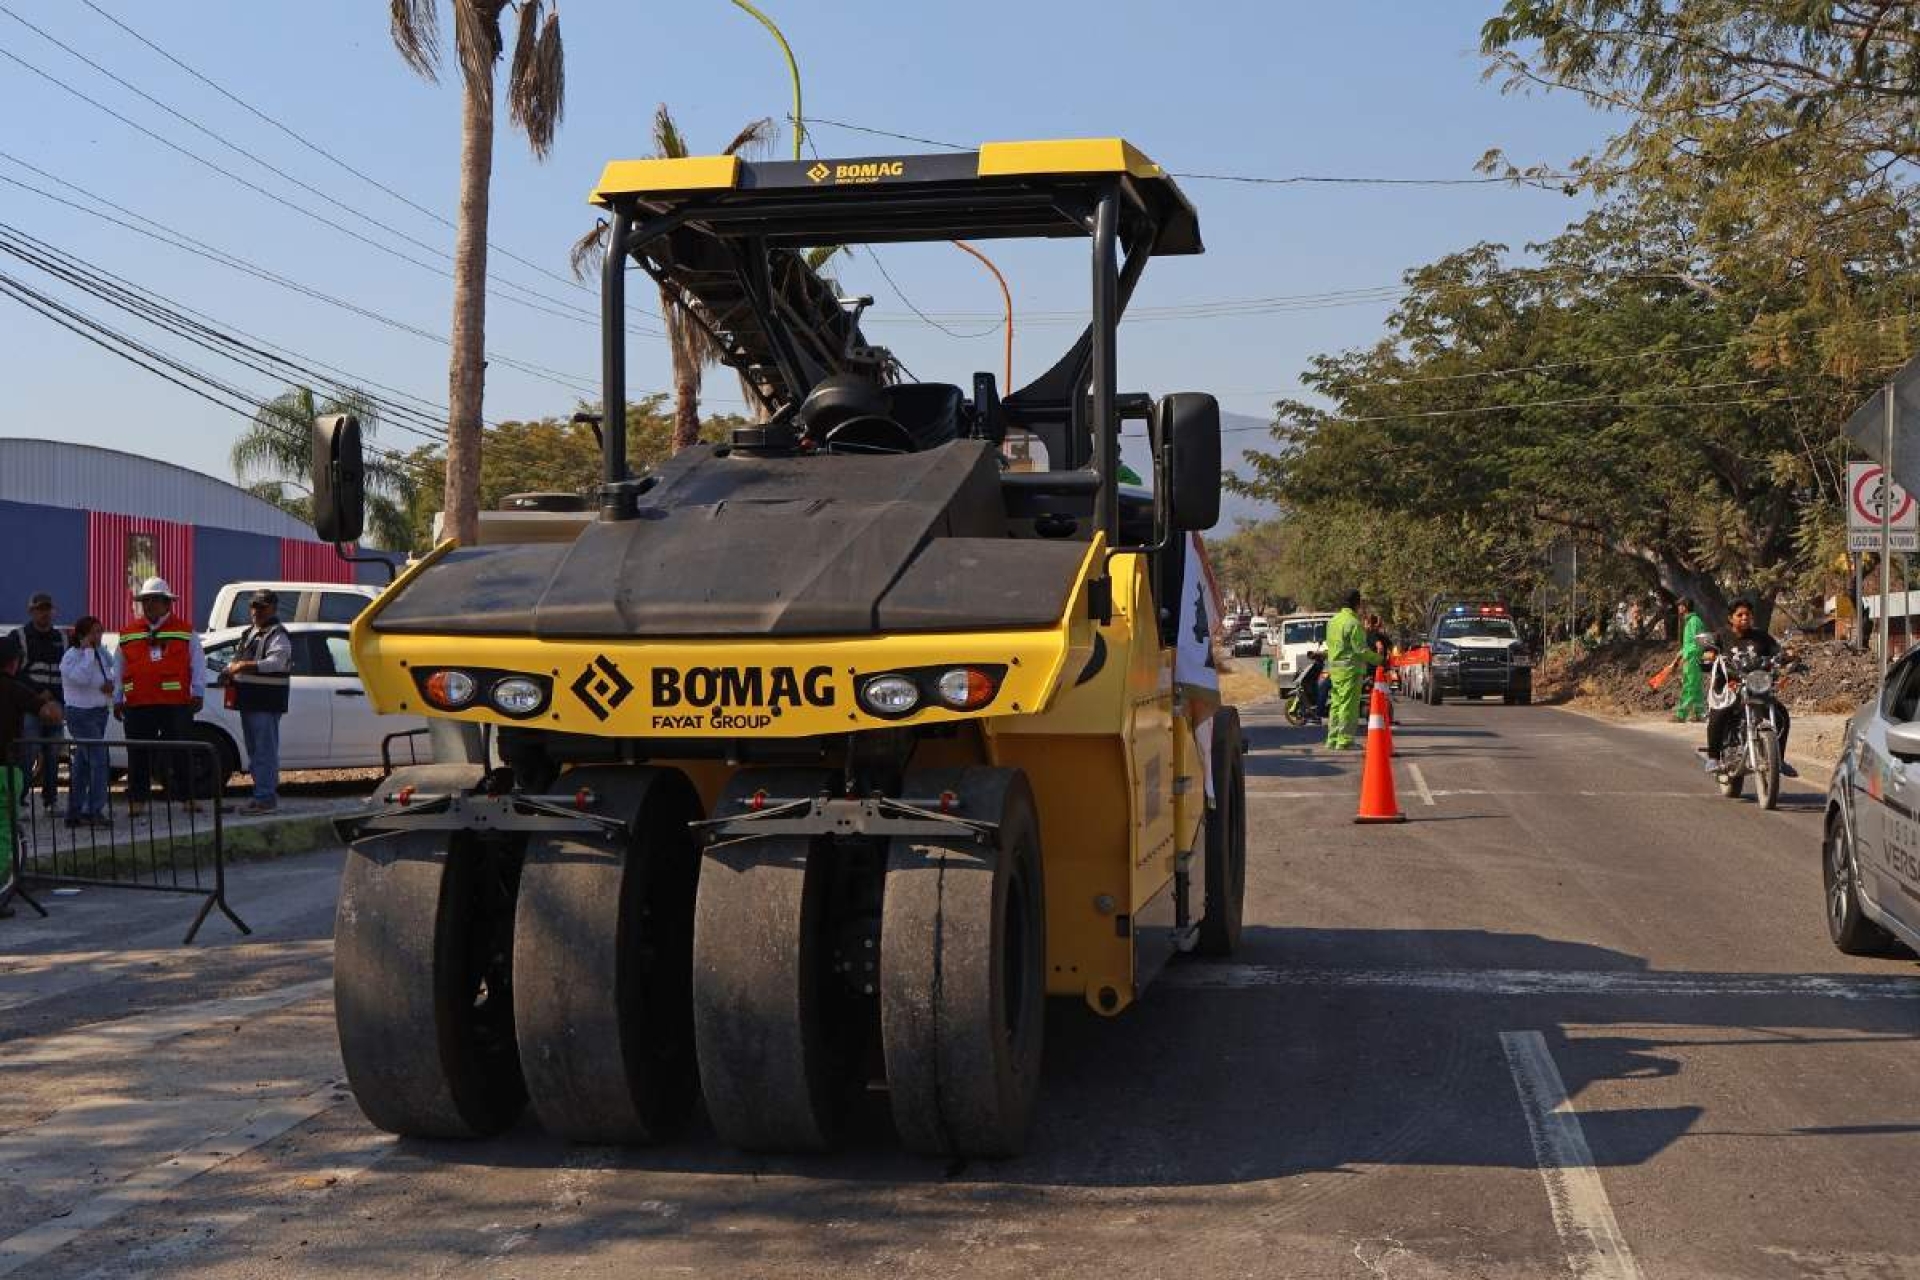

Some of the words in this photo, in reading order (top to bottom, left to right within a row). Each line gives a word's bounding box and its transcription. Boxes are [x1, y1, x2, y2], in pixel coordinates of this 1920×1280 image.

[836, 162, 903, 178] BOMAG
[652, 666, 836, 708] BOMAG
[652, 715, 704, 729] FAYAT
[710, 715, 771, 729] GROUP
